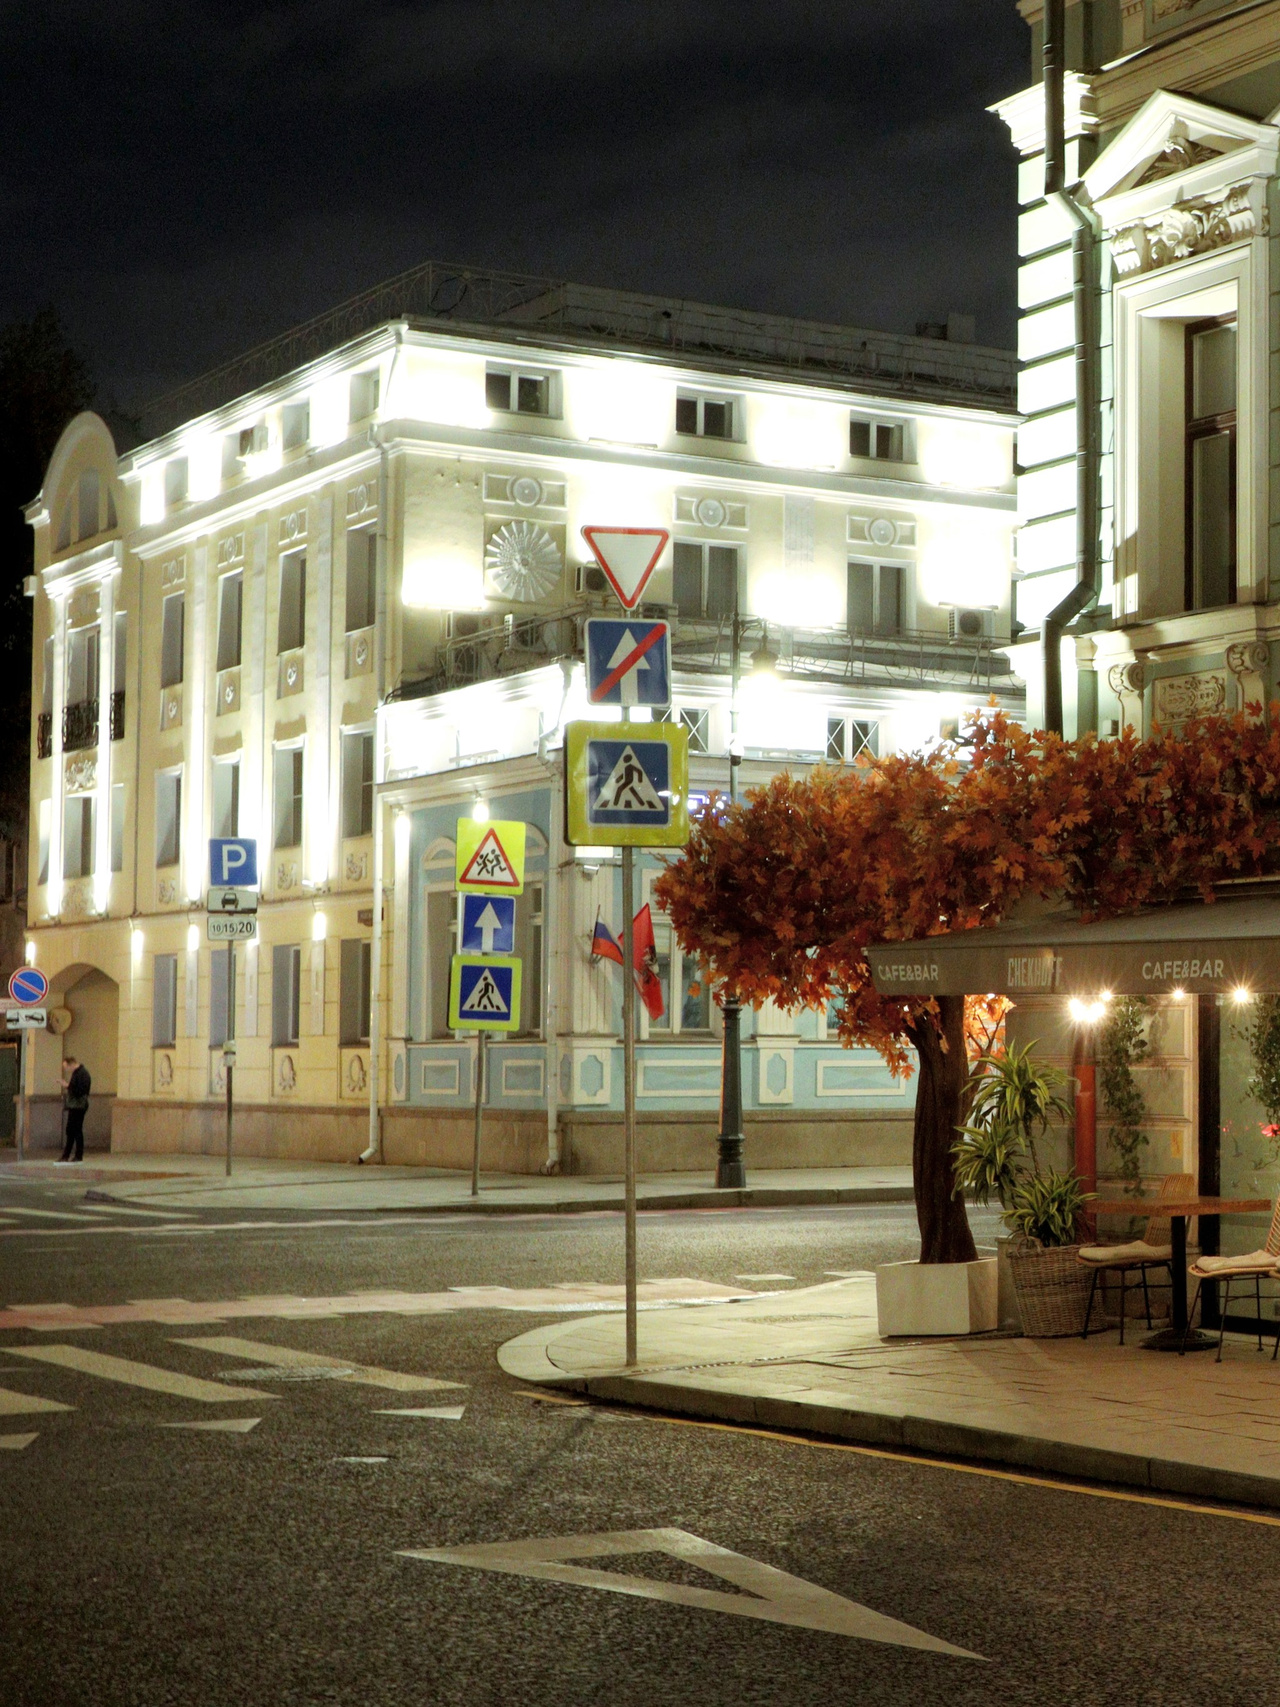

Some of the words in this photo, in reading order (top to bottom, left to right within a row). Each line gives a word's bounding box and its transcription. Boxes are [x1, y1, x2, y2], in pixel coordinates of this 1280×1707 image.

[222, 844, 247, 881] P
[212, 924, 221, 933] 10
[224, 923, 235, 933] 15
[238, 921, 252, 933] 20
[878, 964, 939, 982] CAFE&BAR
[1007, 957, 1063, 987] CHEKHOFF
[1142, 959, 1224, 980] CAFE&BAR
